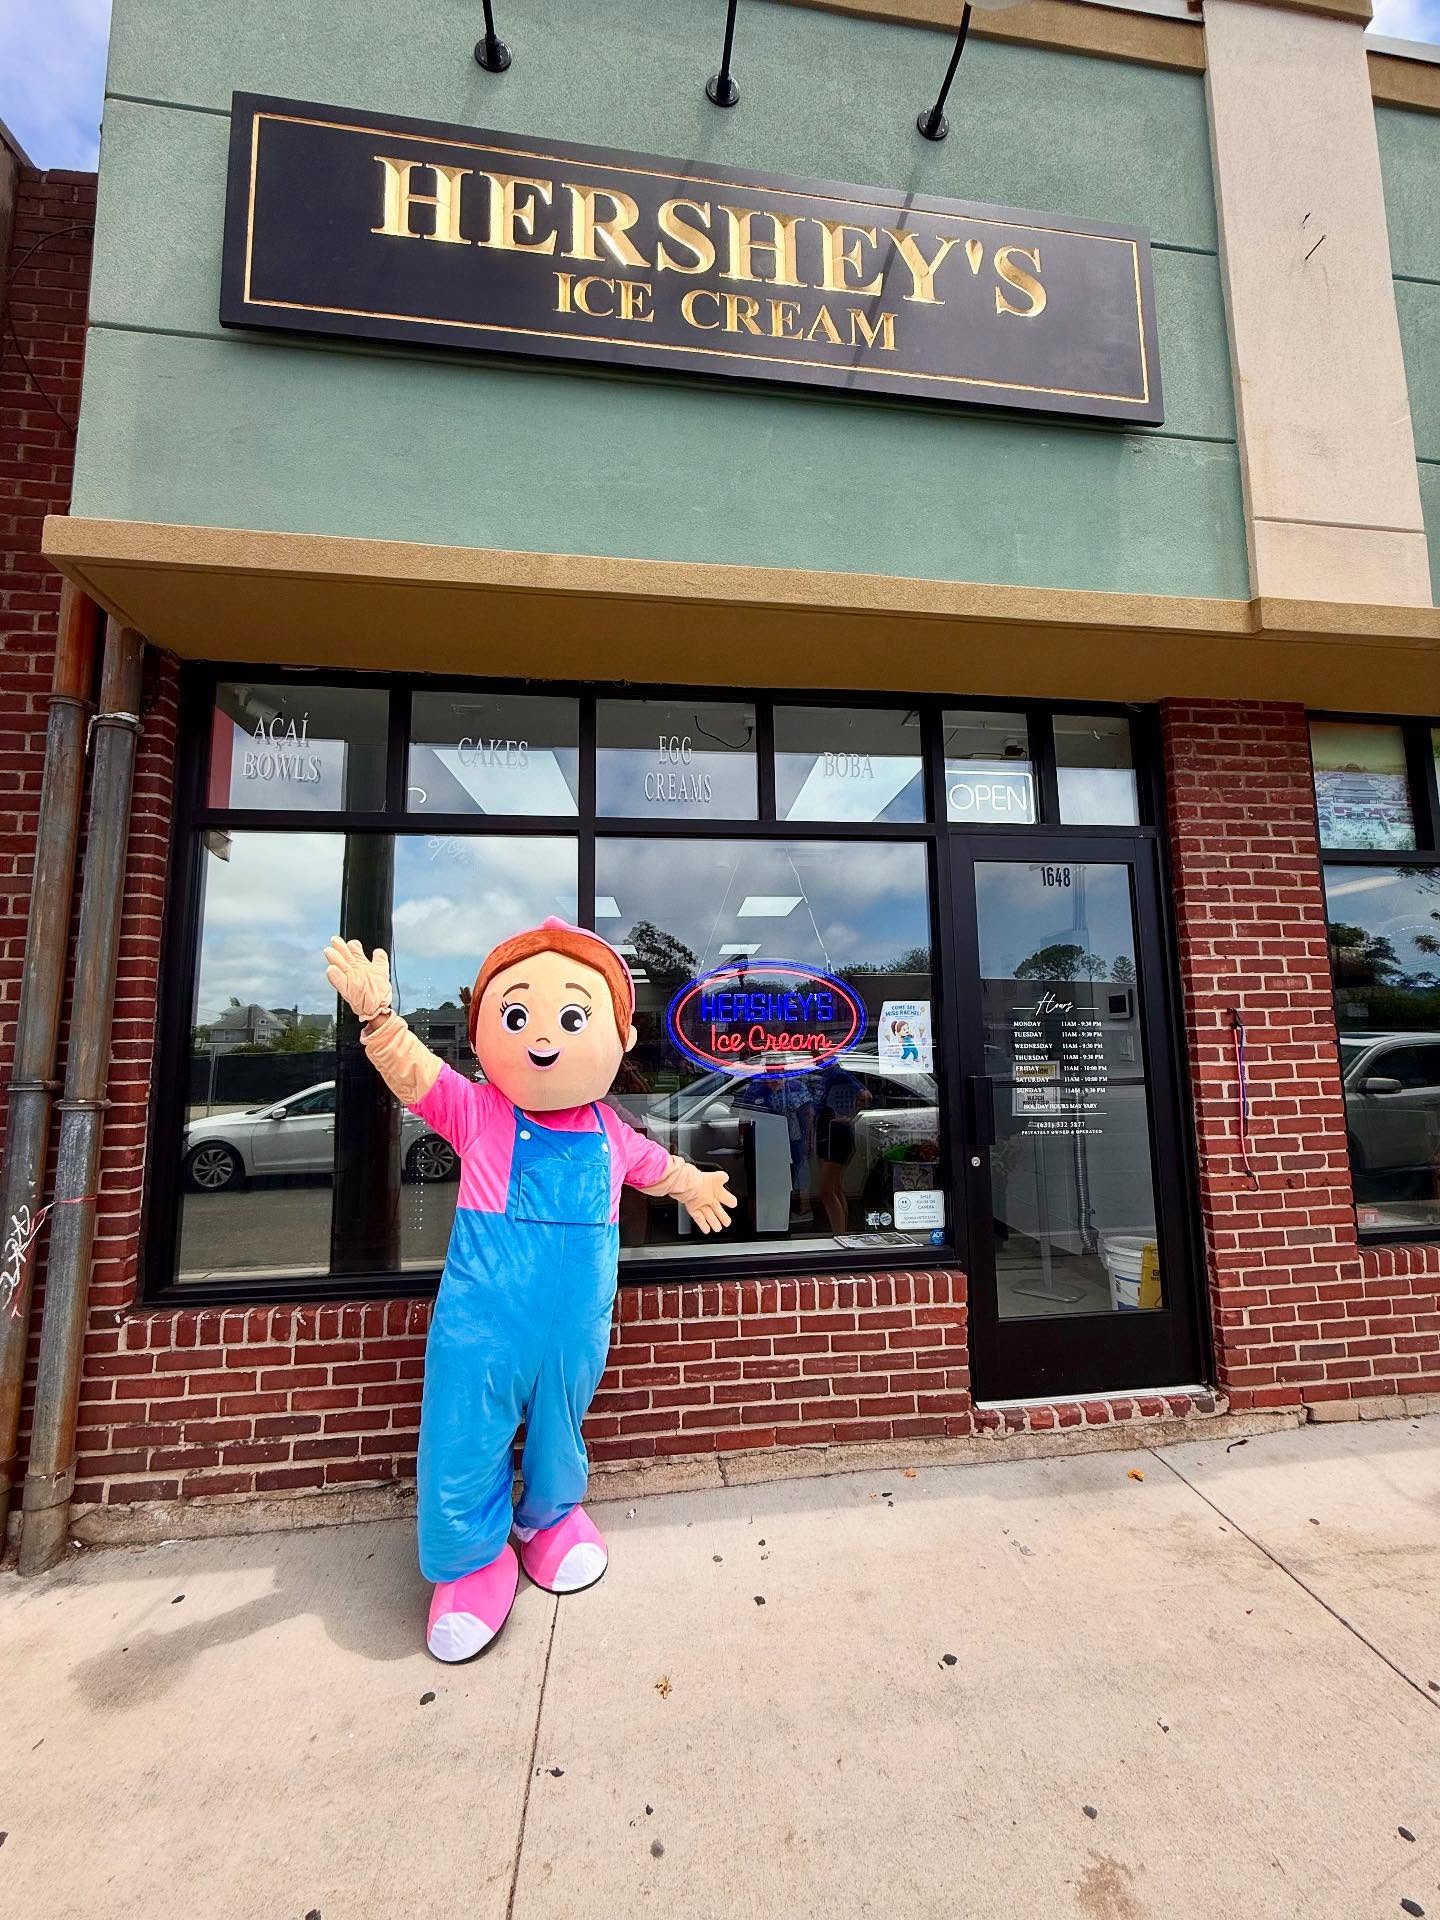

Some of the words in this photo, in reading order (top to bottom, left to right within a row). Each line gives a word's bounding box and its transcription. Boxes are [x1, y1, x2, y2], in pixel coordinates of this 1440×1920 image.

[372, 154, 1048, 318] HERSHEY'S
[552, 271, 655, 321] ICE
[681, 288, 898, 352] CREAM
[252, 711, 310, 747] AÇAÍ
[457, 736, 529, 767] CAKES
[658, 735, 693, 765] EGG
[242, 751, 321, 782] BOWLS
[823, 751, 876, 780] BOBA
[643, 772, 713, 802] CREAMS
[949, 784, 1027, 811] OPEN
[1040, 866, 1071, 888] 1648
[701, 992, 833, 1022] HERSHEY'S
[1036, 992, 1074, 1016] Hours
[711, 1024, 745, 1052] Ice
[749, 1025, 832, 1051] Cream
